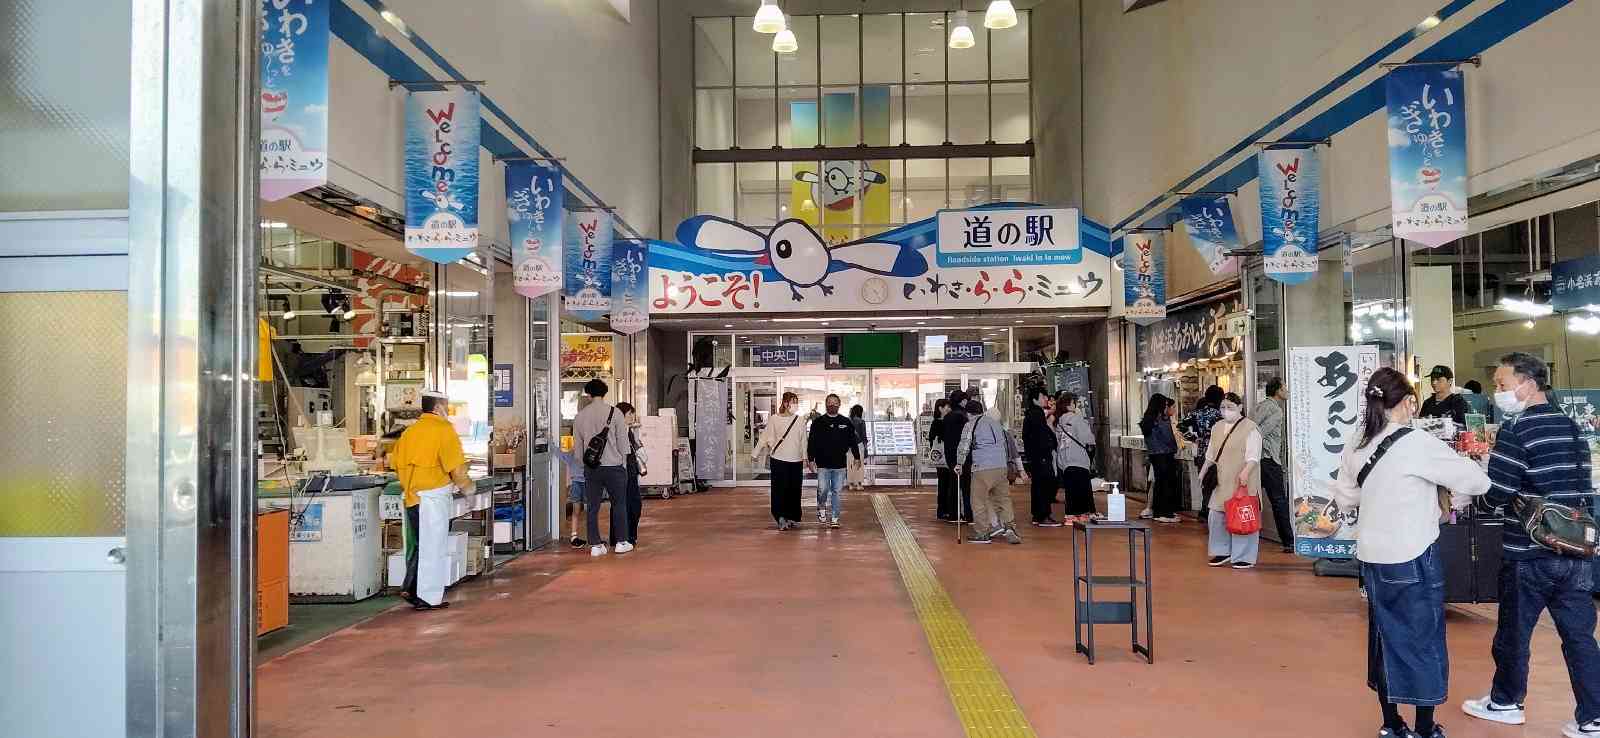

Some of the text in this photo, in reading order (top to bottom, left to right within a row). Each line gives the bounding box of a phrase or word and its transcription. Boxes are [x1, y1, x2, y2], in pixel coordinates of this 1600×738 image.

[963, 215, 1055, 249] 道の駅
[761, 349, 798, 362] 中央口
[945, 344, 983, 358] 中央口
